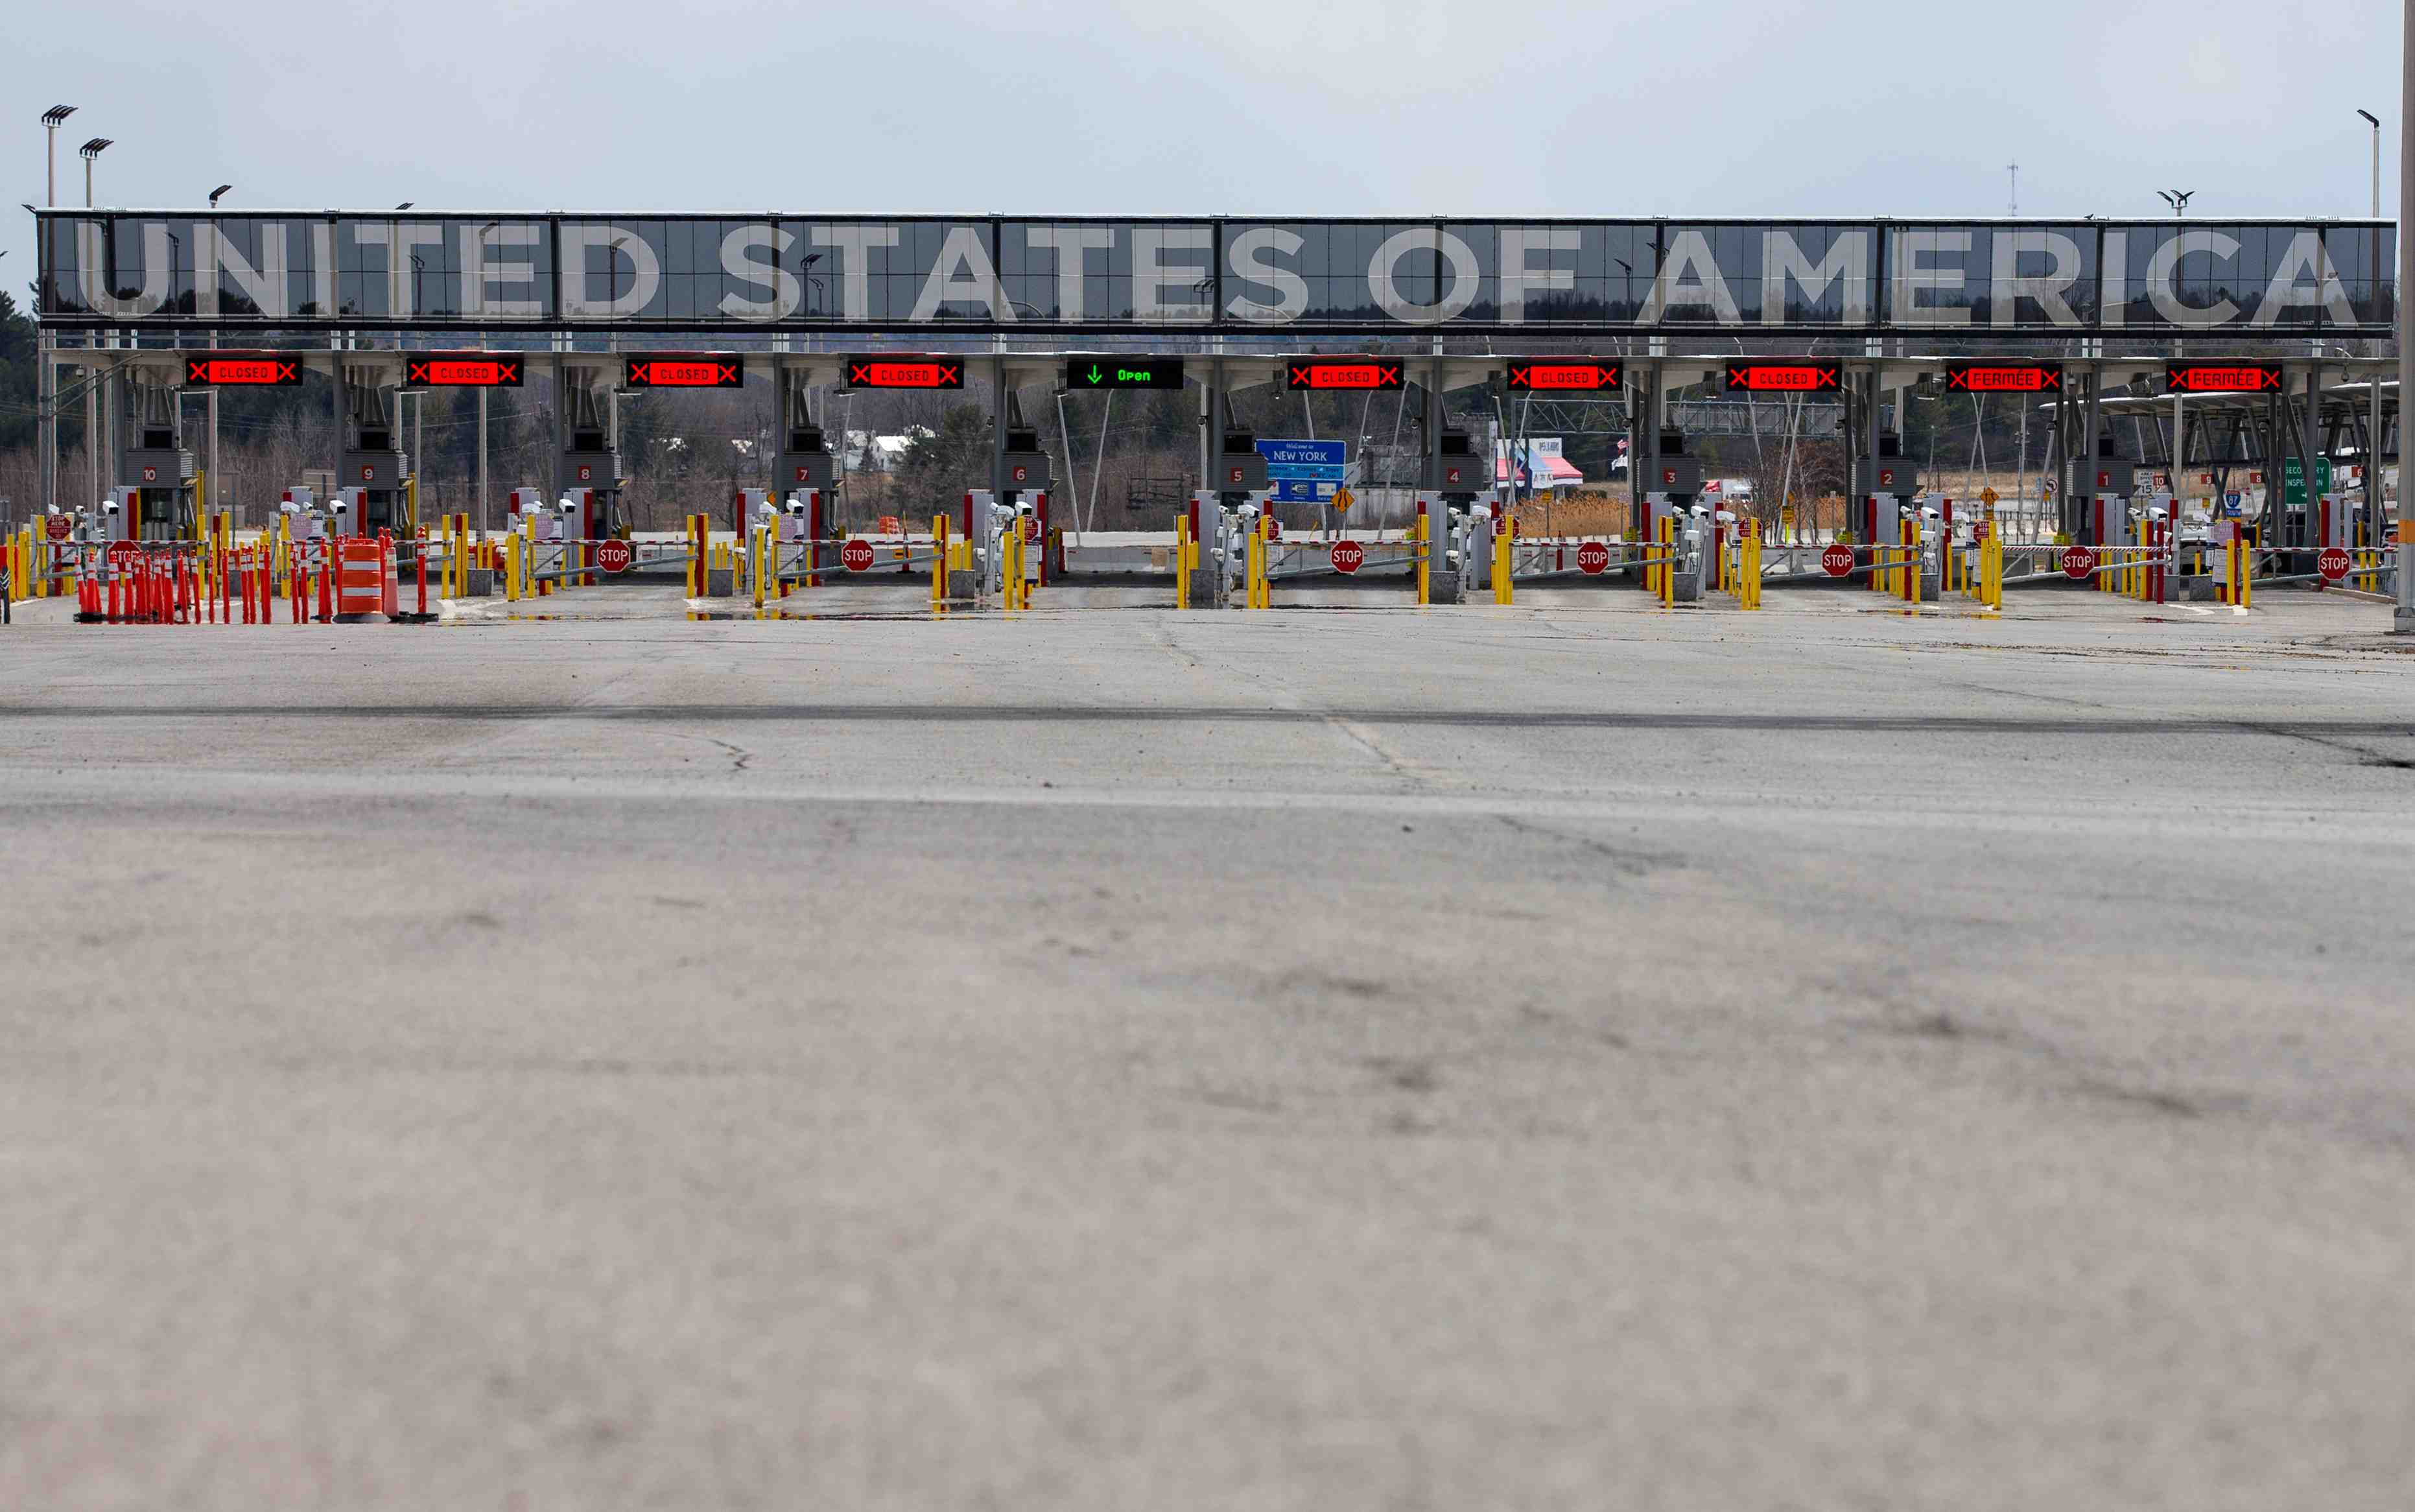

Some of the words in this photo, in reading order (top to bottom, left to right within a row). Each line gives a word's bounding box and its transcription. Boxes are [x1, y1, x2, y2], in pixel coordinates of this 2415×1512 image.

[76, 222, 660, 320] UNITED
[716, 225, 1309, 324] STATES
[1367, 228, 1581, 324] OF
[1634, 231, 2359, 327] AMERICA
[219, 367, 268, 379] CLOSED
[440, 368, 489, 379] CLOSED
[660, 368, 709, 380] CLOSED
[881, 370, 929, 381] CLOSED
[1118, 369, 1151, 381] Open
[1322, 371, 1370, 383] CLOSED
[1541, 372, 1589, 384] CLOSED
[1760, 373, 1808, 384] CLOSED
[1973, 369, 2033, 386] FERMÉE
[2194, 369, 2253, 386] FERMÉE
[1274, 451, 1296, 460] NEW
[1299, 451, 1327, 461] YORK
[144, 469, 156, 480] 10
[364, 468, 373, 479] 9
[582, 469, 589, 479] 8
[801, 469, 808, 480] 7
[1017, 469, 1025, 480] 6
[1234, 470, 1242, 481] 5
[1450, 471, 1459, 481] 4
[1667, 472, 1676, 483] 3
[2357, 468, 2362, 477] 6
[1883, 473, 1892, 484] 2
[2103, 474, 2109, 485] 1
[2156, 477, 2164, 486] 10
[2206, 476, 2211, 484] 9
[2229, 495, 2237, 505] 87
[600, 549, 628, 561] STOP
[845, 549, 873, 561] STOP
[1334, 550, 1361, 562] STOP
[1579, 552, 1607, 564] STOP
[1824, 554, 1852, 567] STOP
[2064, 556, 2091, 568] STOP
[2320, 557, 2348, 570] STOP
